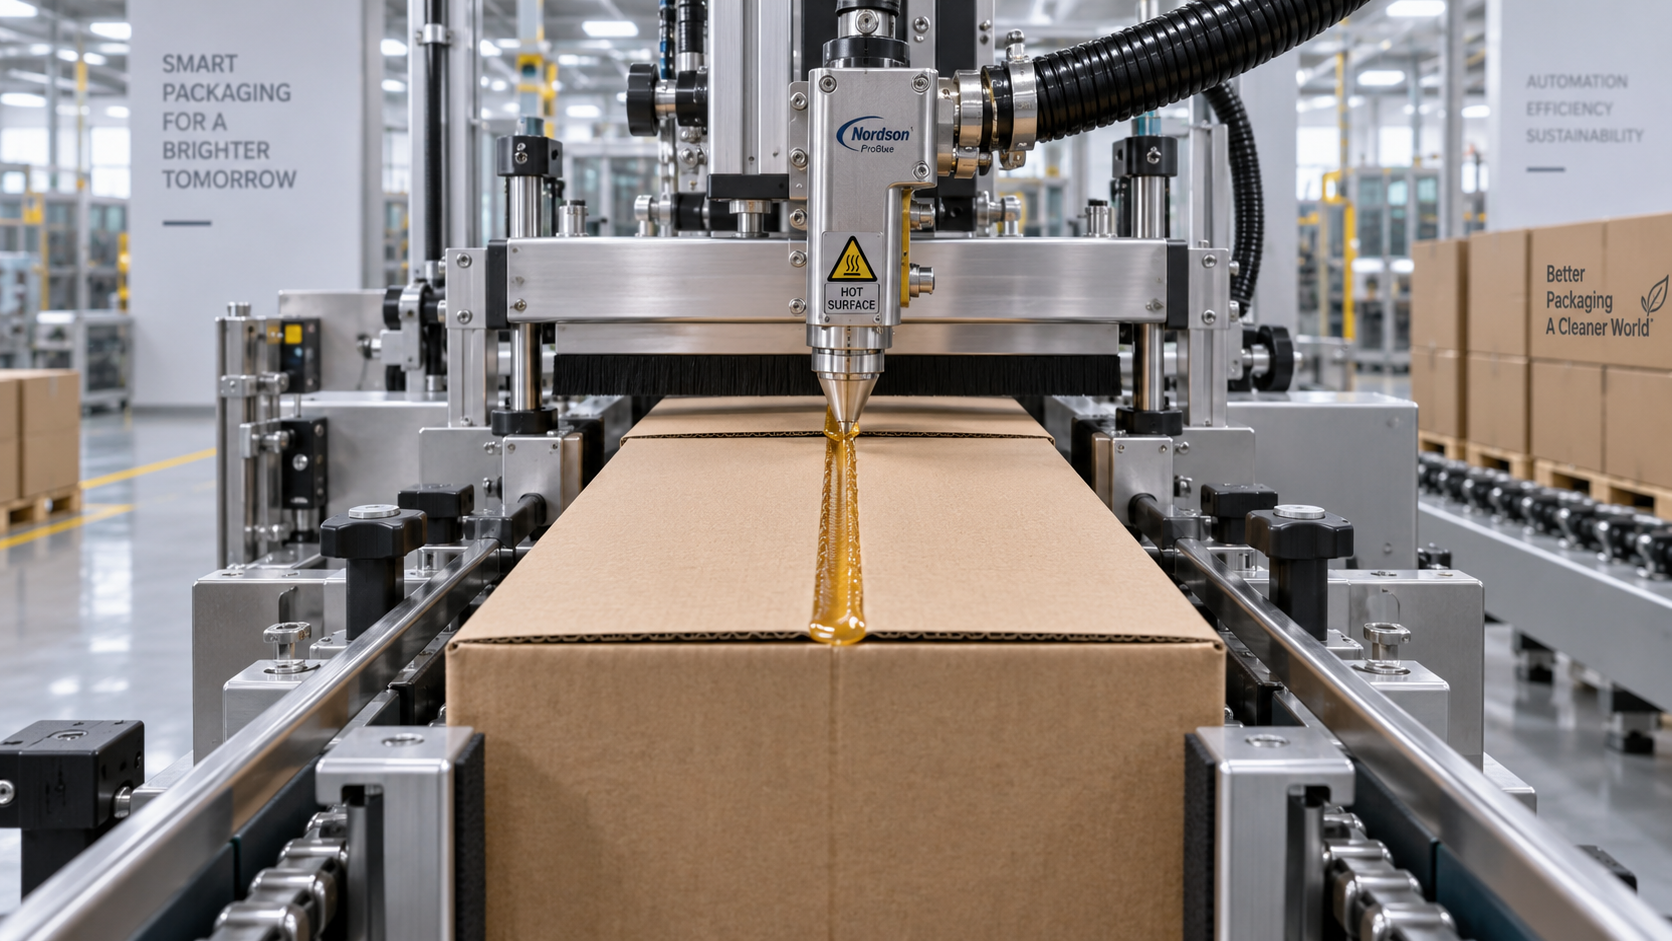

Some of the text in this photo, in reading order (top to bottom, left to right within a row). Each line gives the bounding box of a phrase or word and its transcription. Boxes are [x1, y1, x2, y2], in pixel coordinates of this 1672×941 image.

[162, 53, 238, 74] SMART
[1526, 73, 1628, 89] AUTOMATION
[162, 82, 291, 103] PACKAGING
[1526, 101, 1613, 117] EFFICIENCY
[162, 111, 228, 132] FOR A
[851, 126, 910, 142] Nordson
[1526, 128, 1644, 144] SUSTAINABILITY
[162, 140, 270, 161] BRIGHTER
[161, 169, 297, 190] TOMORROW
[1546, 264, 1586, 283] Better
[841, 286, 864, 297] HOT
[827, 299, 876, 311] SURFACE
[1546, 290, 1613, 314] Packaging
[1545, 317, 1556, 335] A
[1558, 316, 1608, 337] Cleaner
